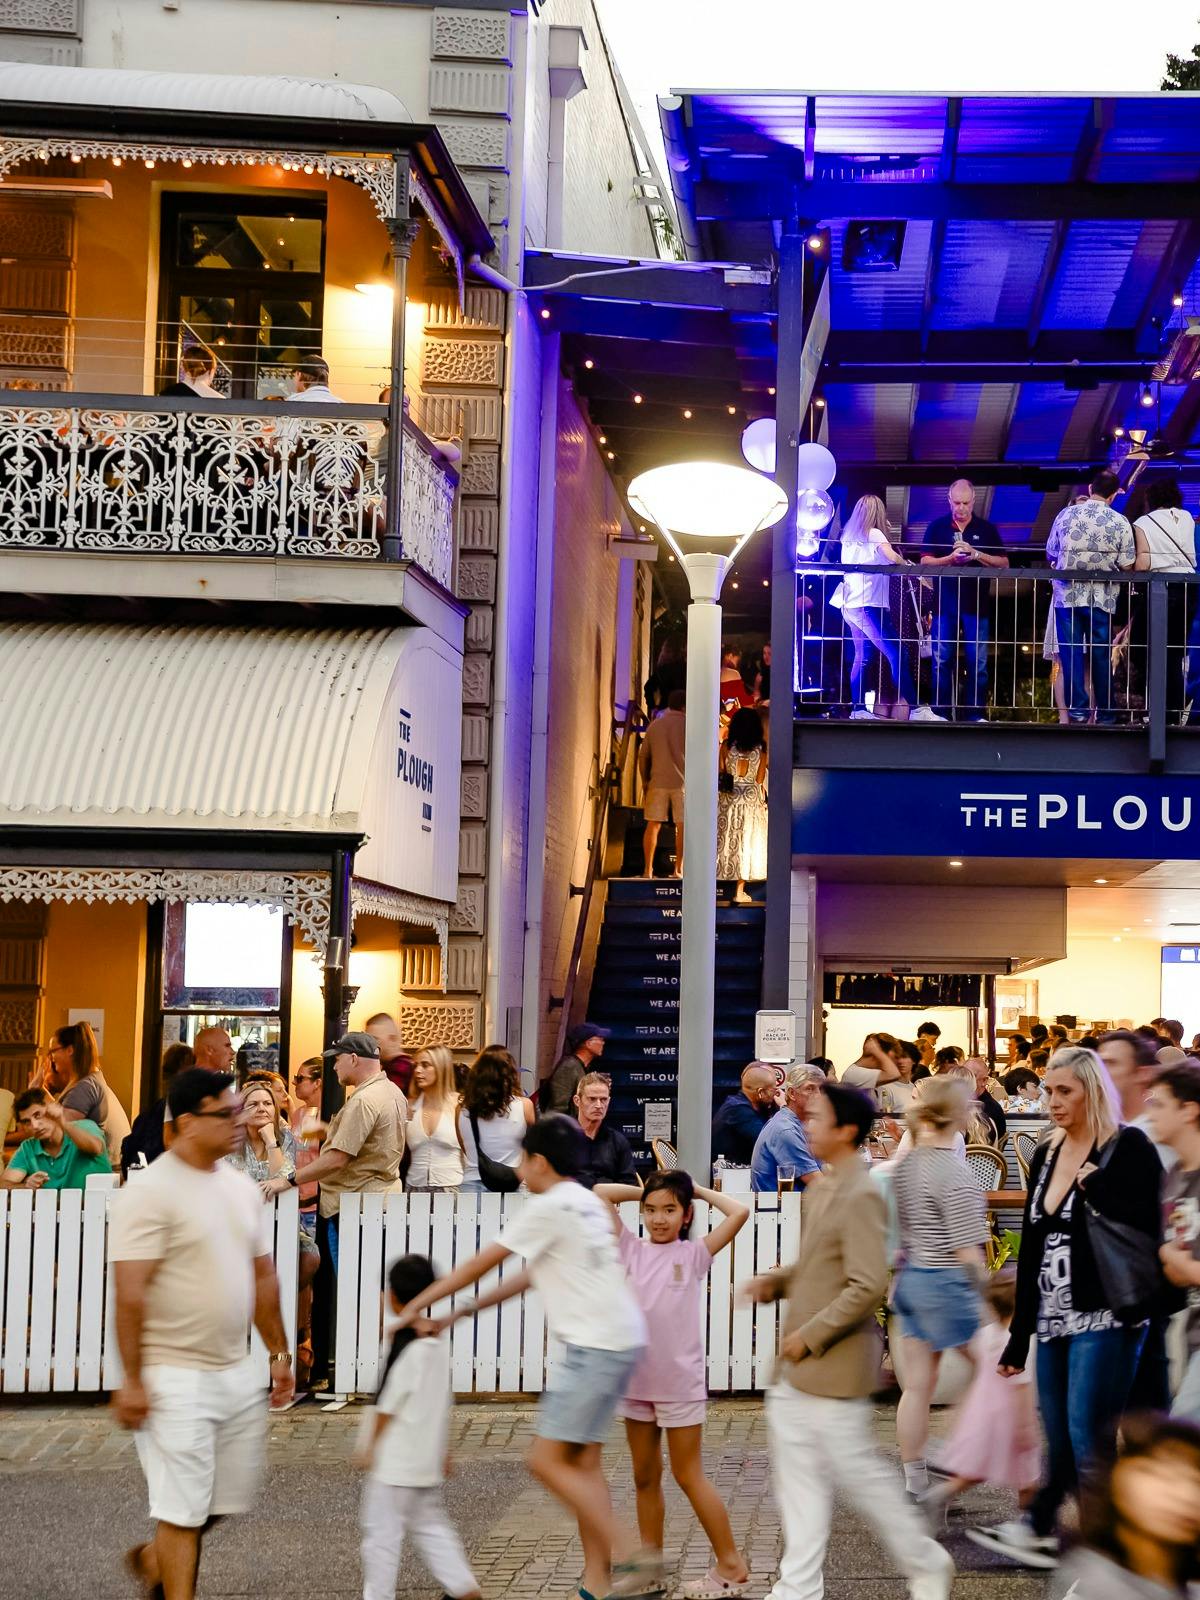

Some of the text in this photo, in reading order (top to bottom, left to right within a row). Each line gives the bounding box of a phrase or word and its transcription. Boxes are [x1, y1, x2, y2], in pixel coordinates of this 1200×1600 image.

[399, 720, 411, 742] THE
[396, 747, 434, 794] PLOUGH
[960, 806, 1028, 828] THE
[657, 977, 678, 985] PLO
[649, 1026, 679, 1034] PLOU
[632, 1151, 644, 1159] WE
